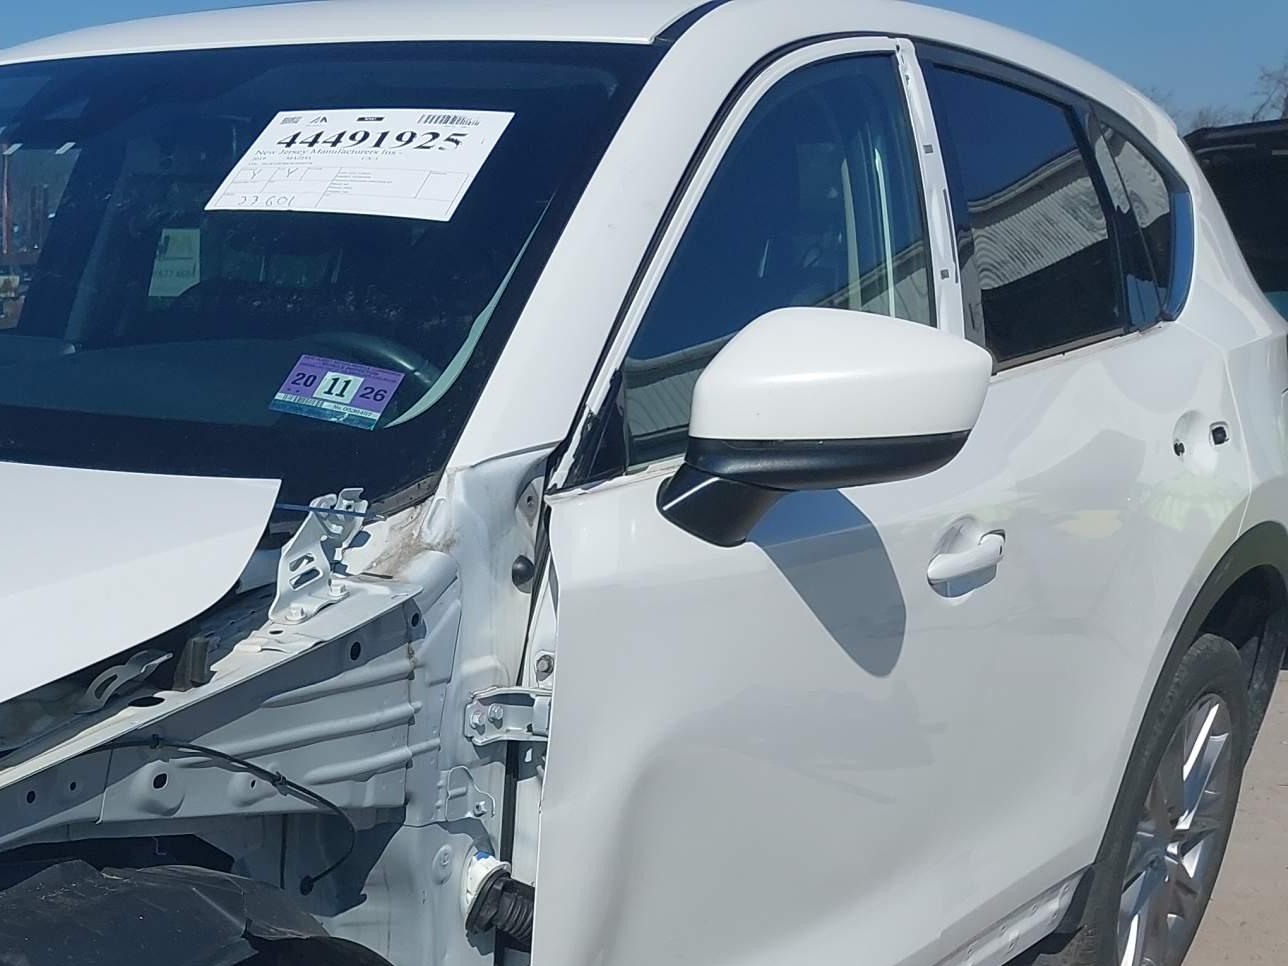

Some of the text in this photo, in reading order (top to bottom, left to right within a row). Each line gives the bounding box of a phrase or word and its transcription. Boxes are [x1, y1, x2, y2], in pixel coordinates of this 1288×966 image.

[277, 130, 468, 150] 44491925
[291, 372, 387, 402] 20 11 26
